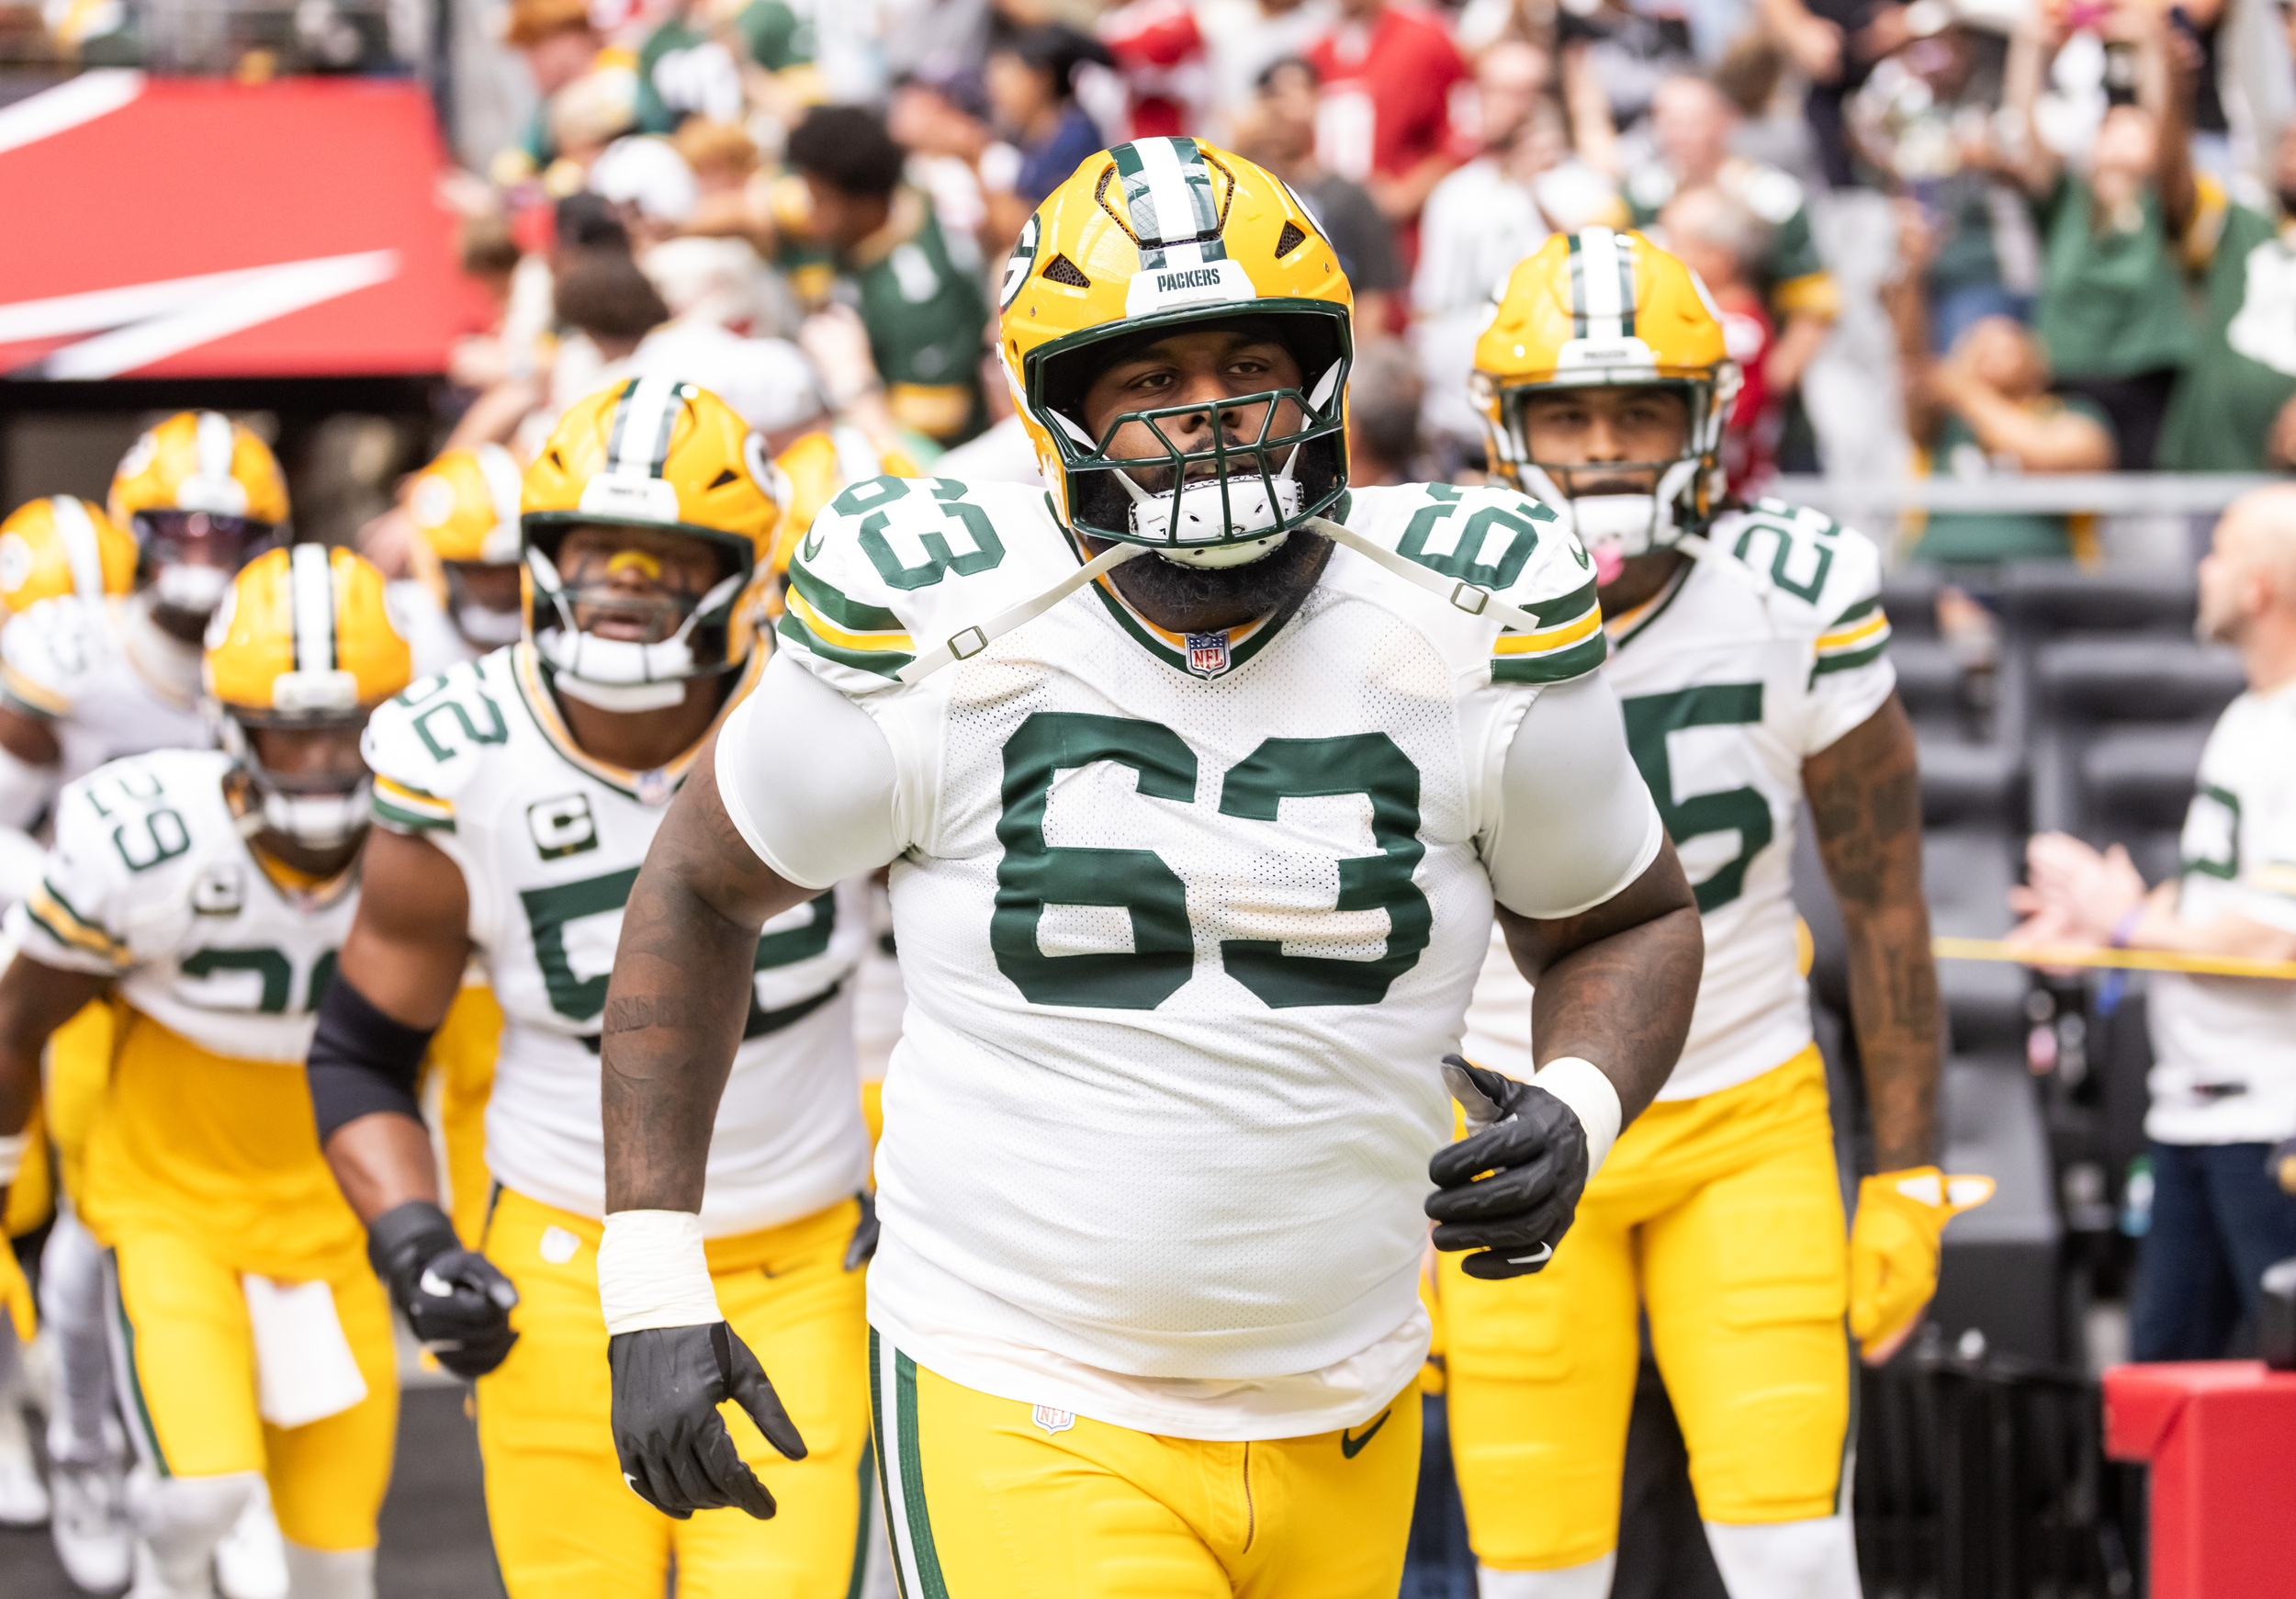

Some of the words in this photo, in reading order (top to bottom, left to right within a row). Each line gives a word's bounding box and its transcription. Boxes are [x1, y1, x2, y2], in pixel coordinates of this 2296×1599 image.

[1156, 267, 1221, 293] PACKERS
[1395, 480, 1559, 591] 6
[1193, 648, 1223, 670] NFL
[990, 711, 1434, 1010] 63
[1039, 1405, 1068, 1425] NFL
